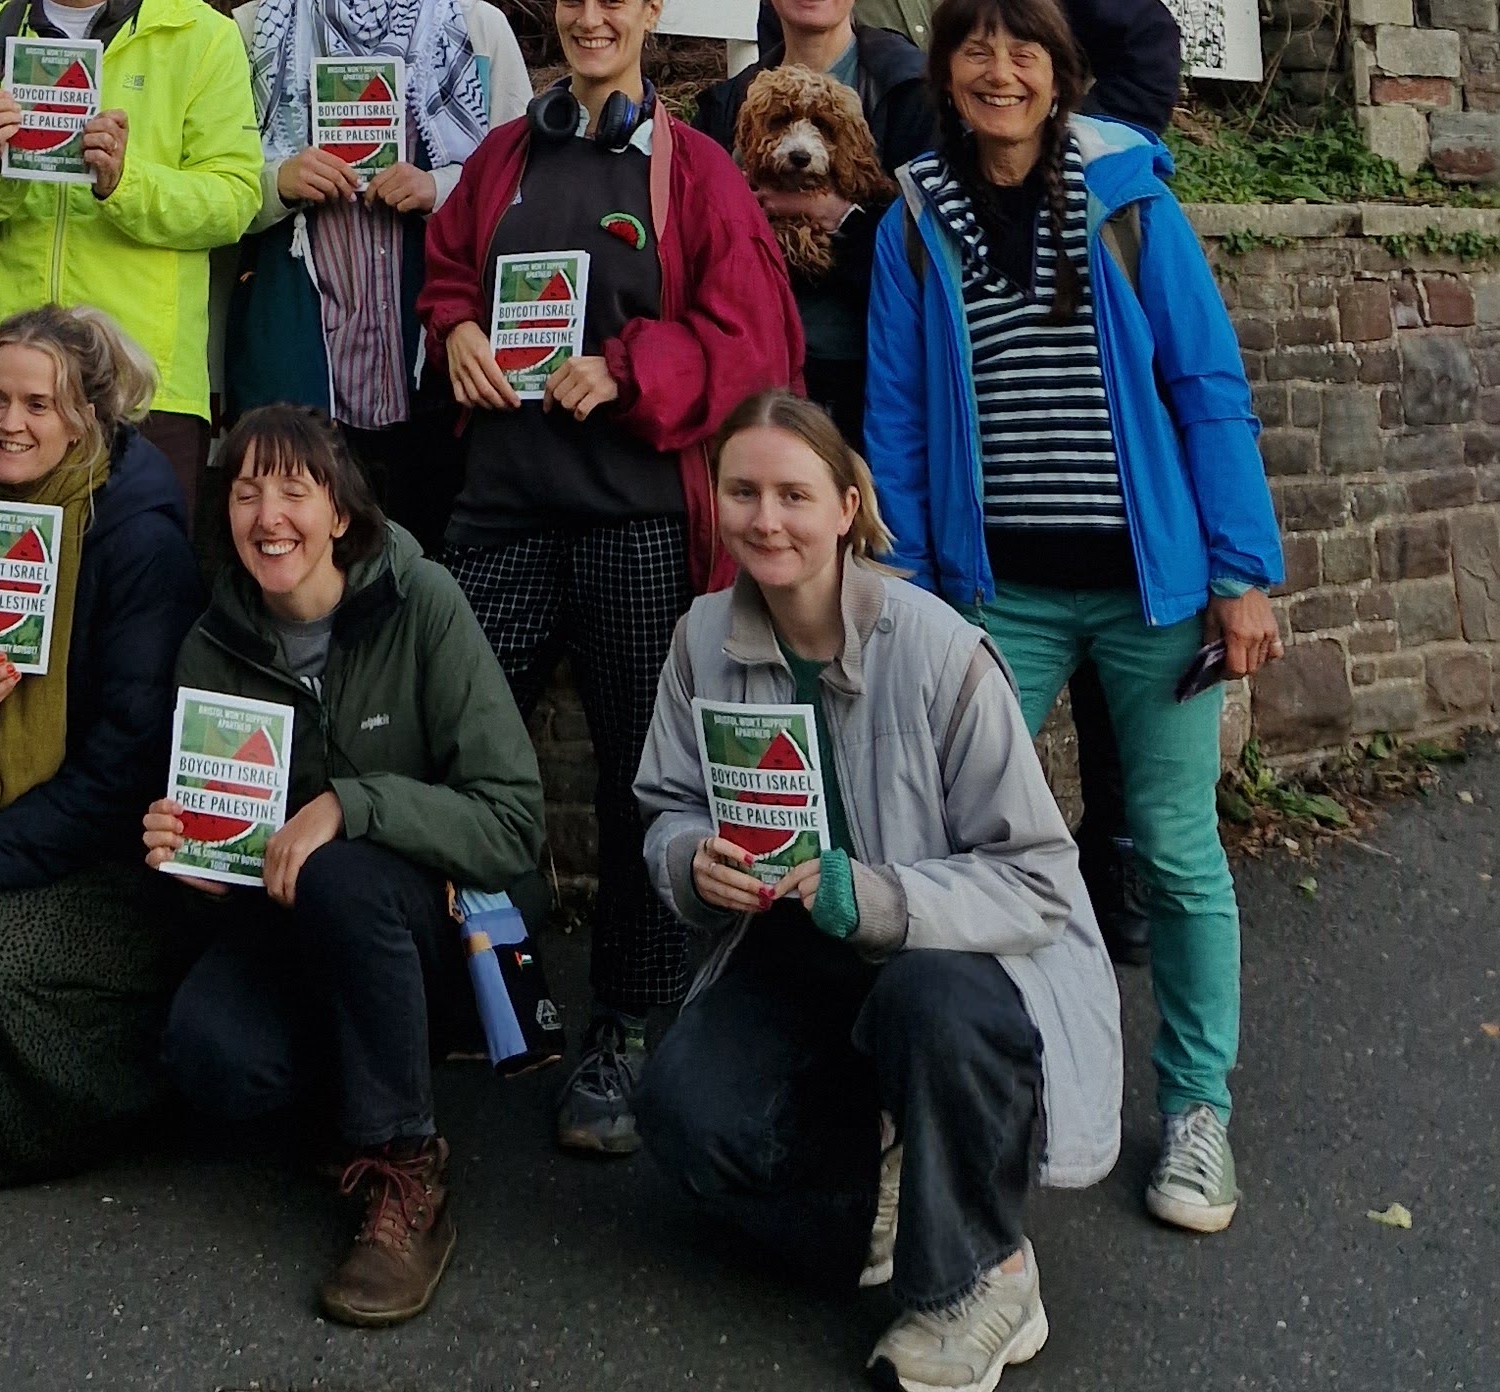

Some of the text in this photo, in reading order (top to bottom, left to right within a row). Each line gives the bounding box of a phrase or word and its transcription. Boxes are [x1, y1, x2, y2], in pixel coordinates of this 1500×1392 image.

[13, 87, 95, 104] BOYCOTT ISRAEL
[318, 105, 397, 116] BOYCOTT ISRAEL
[20, 114, 36, 127] EE
[319, 130, 397, 141] FREE PALESTINE
[499, 304, 575, 318] BOYCOTT ISRAEL
[497, 331, 573, 346] FREE PALESTINE
[10, 563, 49, 581] ISRAEL
[179, 757, 280, 788] BOYCOTT ISRAEL
[711, 766, 815, 792] BOYCOTT ISRAEL
[176, 790, 277, 821] FREE PALESTINE
[715, 801, 818, 828] FREE PALESTINE
